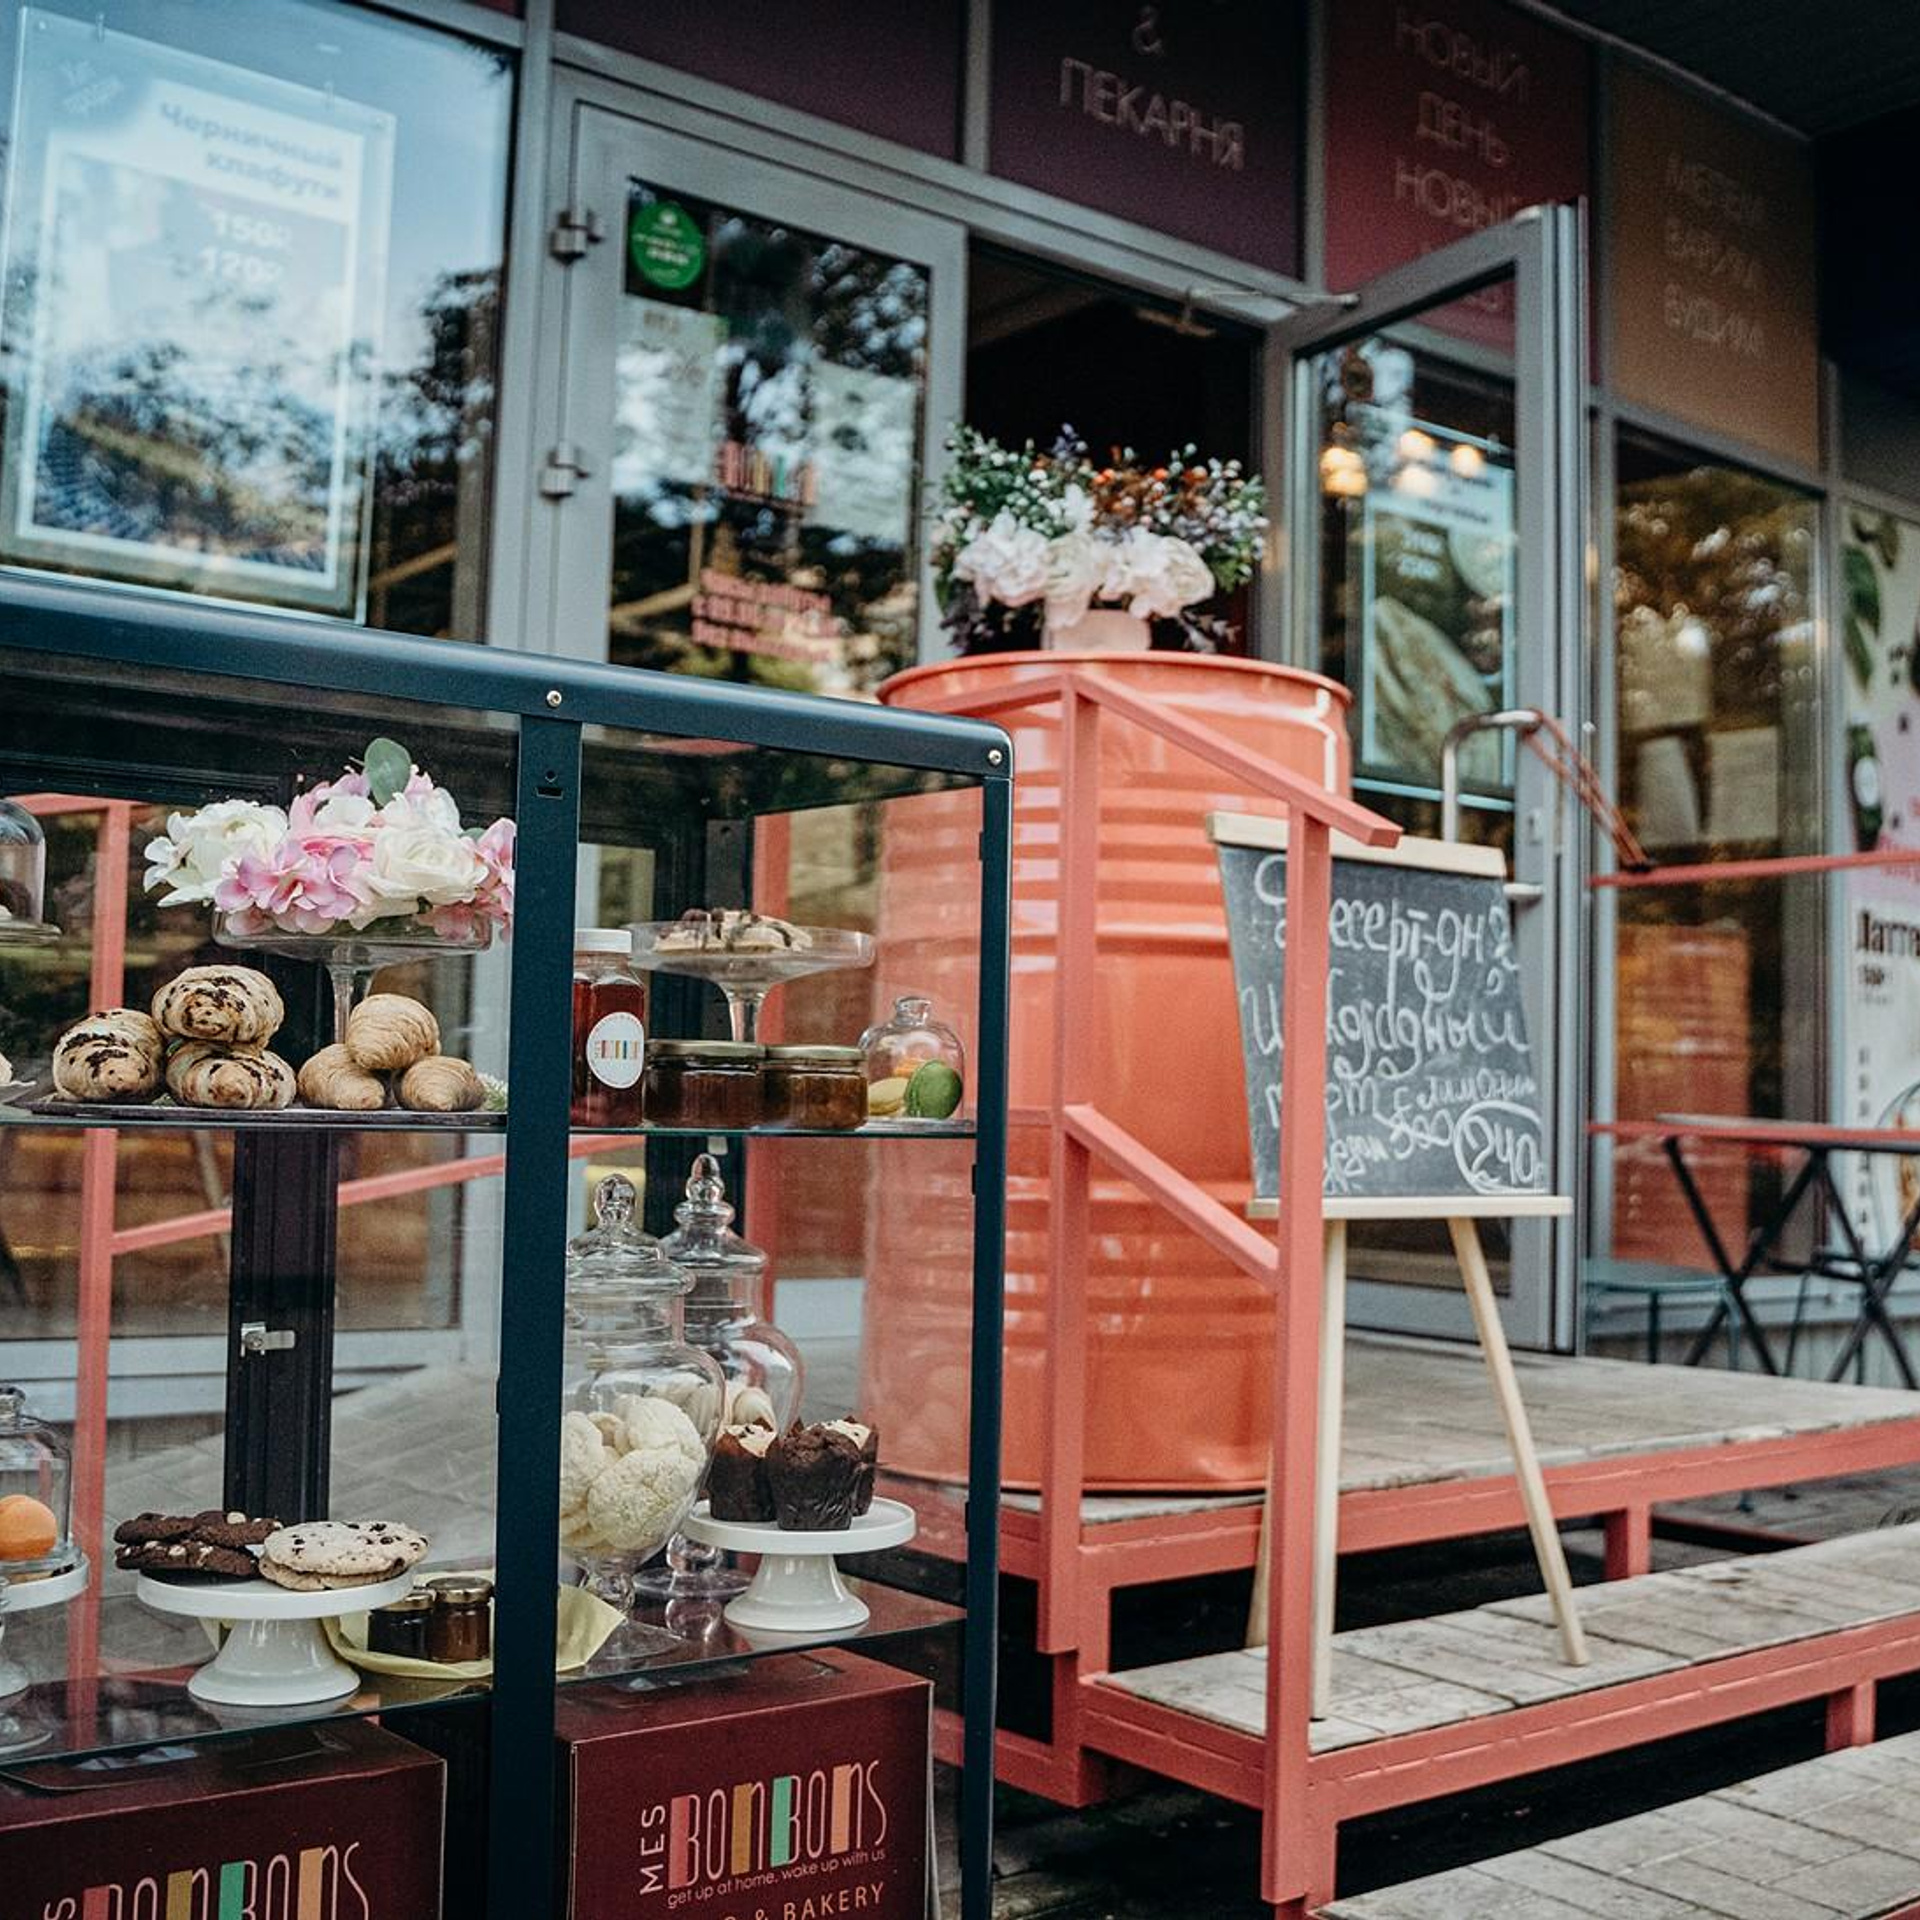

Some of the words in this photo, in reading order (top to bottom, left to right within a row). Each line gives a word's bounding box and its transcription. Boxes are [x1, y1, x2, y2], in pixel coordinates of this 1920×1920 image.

[1132, 4, 1165, 56] &
[1395, 5, 1529, 104] НОВЫЙ
[160, 101, 342, 170] Черничный
[1060, 57, 1245, 172] ПЕКАРНЯ
[1416, 91, 1509, 168] ДЕНЬ
[1394, 156, 1520, 230] НОВЫ
[639, 1803, 667, 1896] MES
[667, 1888, 692, 1909] get
[694, 1883, 715, 1902] up
[716, 1878, 732, 1895] at
[781, 1861, 818, 1881] wake
[821, 1857, 839, 1875] up
[841, 1849, 869, 1867] with
[870, 1848, 886, 1861] us
[783, 1881, 885, 1920] BAKERY
